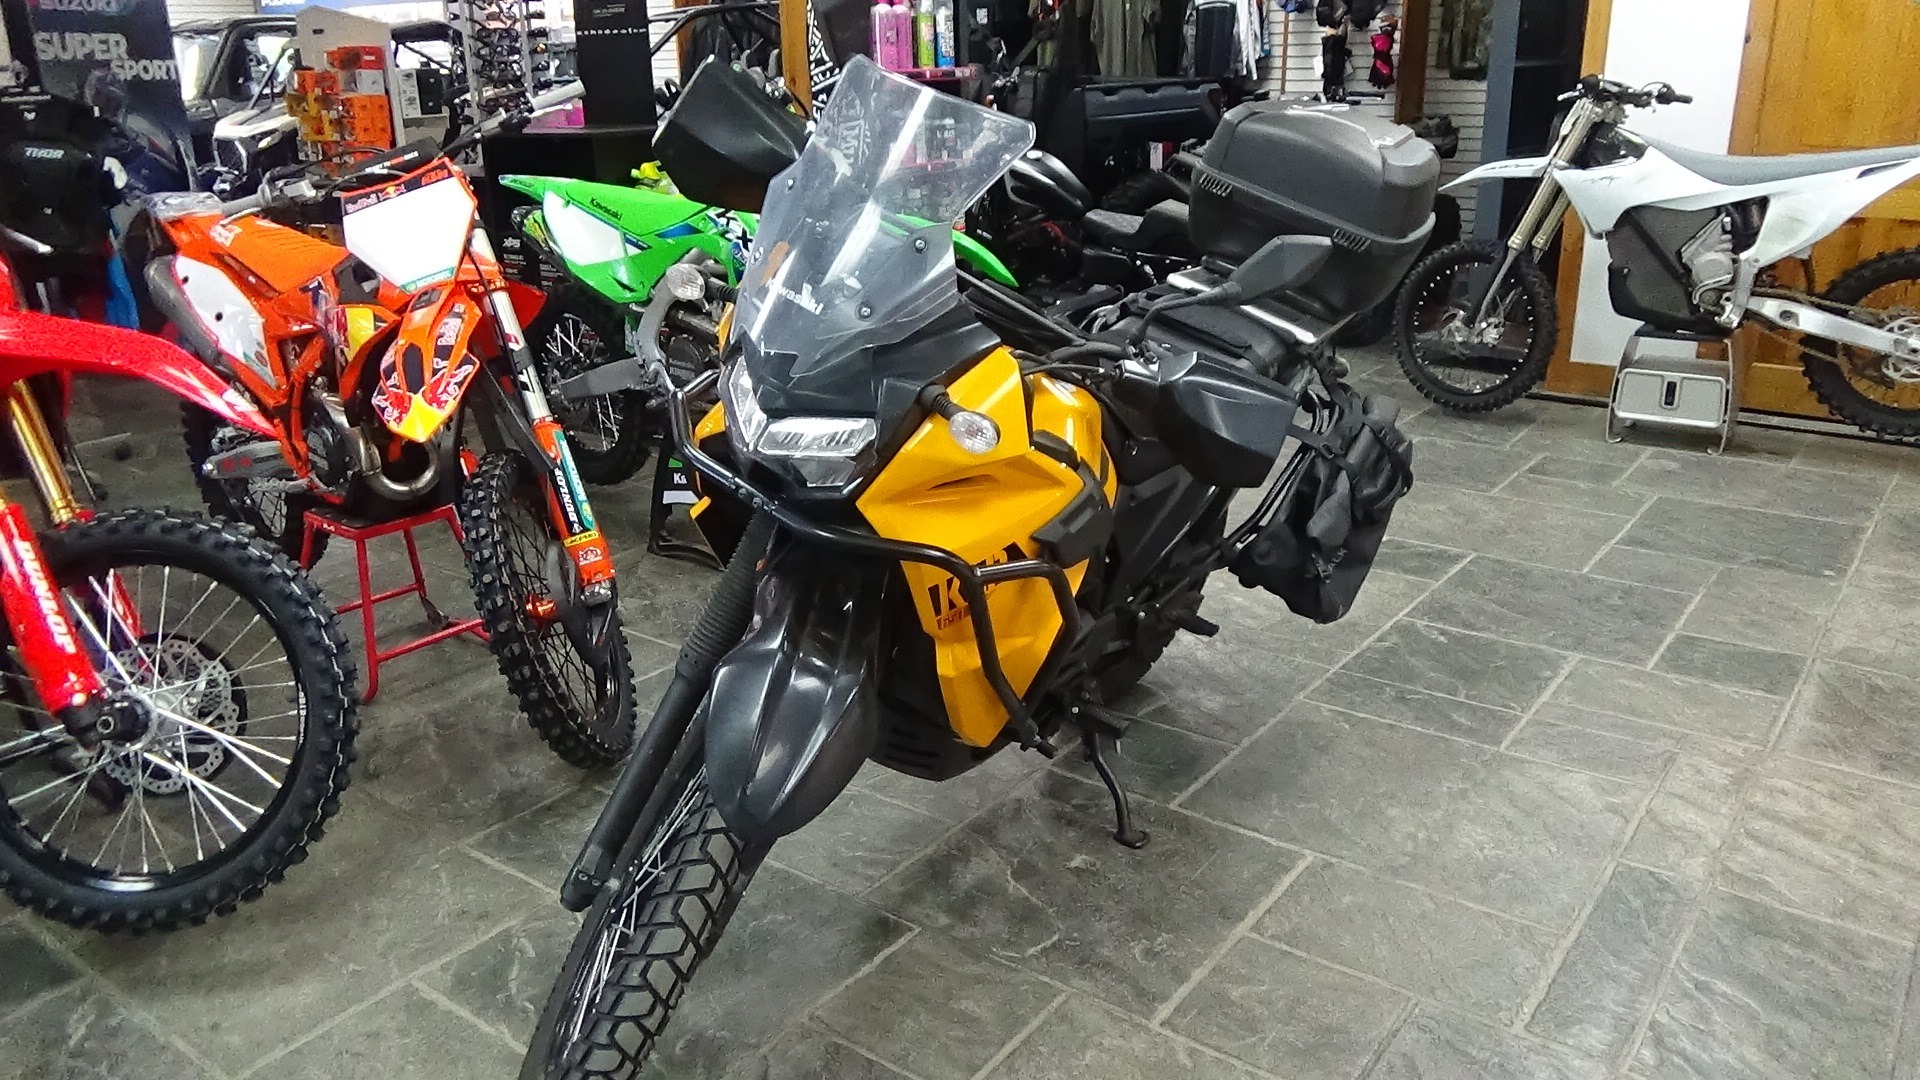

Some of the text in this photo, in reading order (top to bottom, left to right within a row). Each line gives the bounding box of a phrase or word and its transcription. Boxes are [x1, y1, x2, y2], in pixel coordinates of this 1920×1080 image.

[34, 31, 129, 61] SUPER
[111, 59, 178, 81] SPORT
[24, 147, 65, 160] THOR
[590, 196, 623, 221] Kawasaki
[765, 277, 824, 315] Kwaski
[554, 467, 579, 522] DUNLOP
[13, 539, 77, 654] DUNLOP
